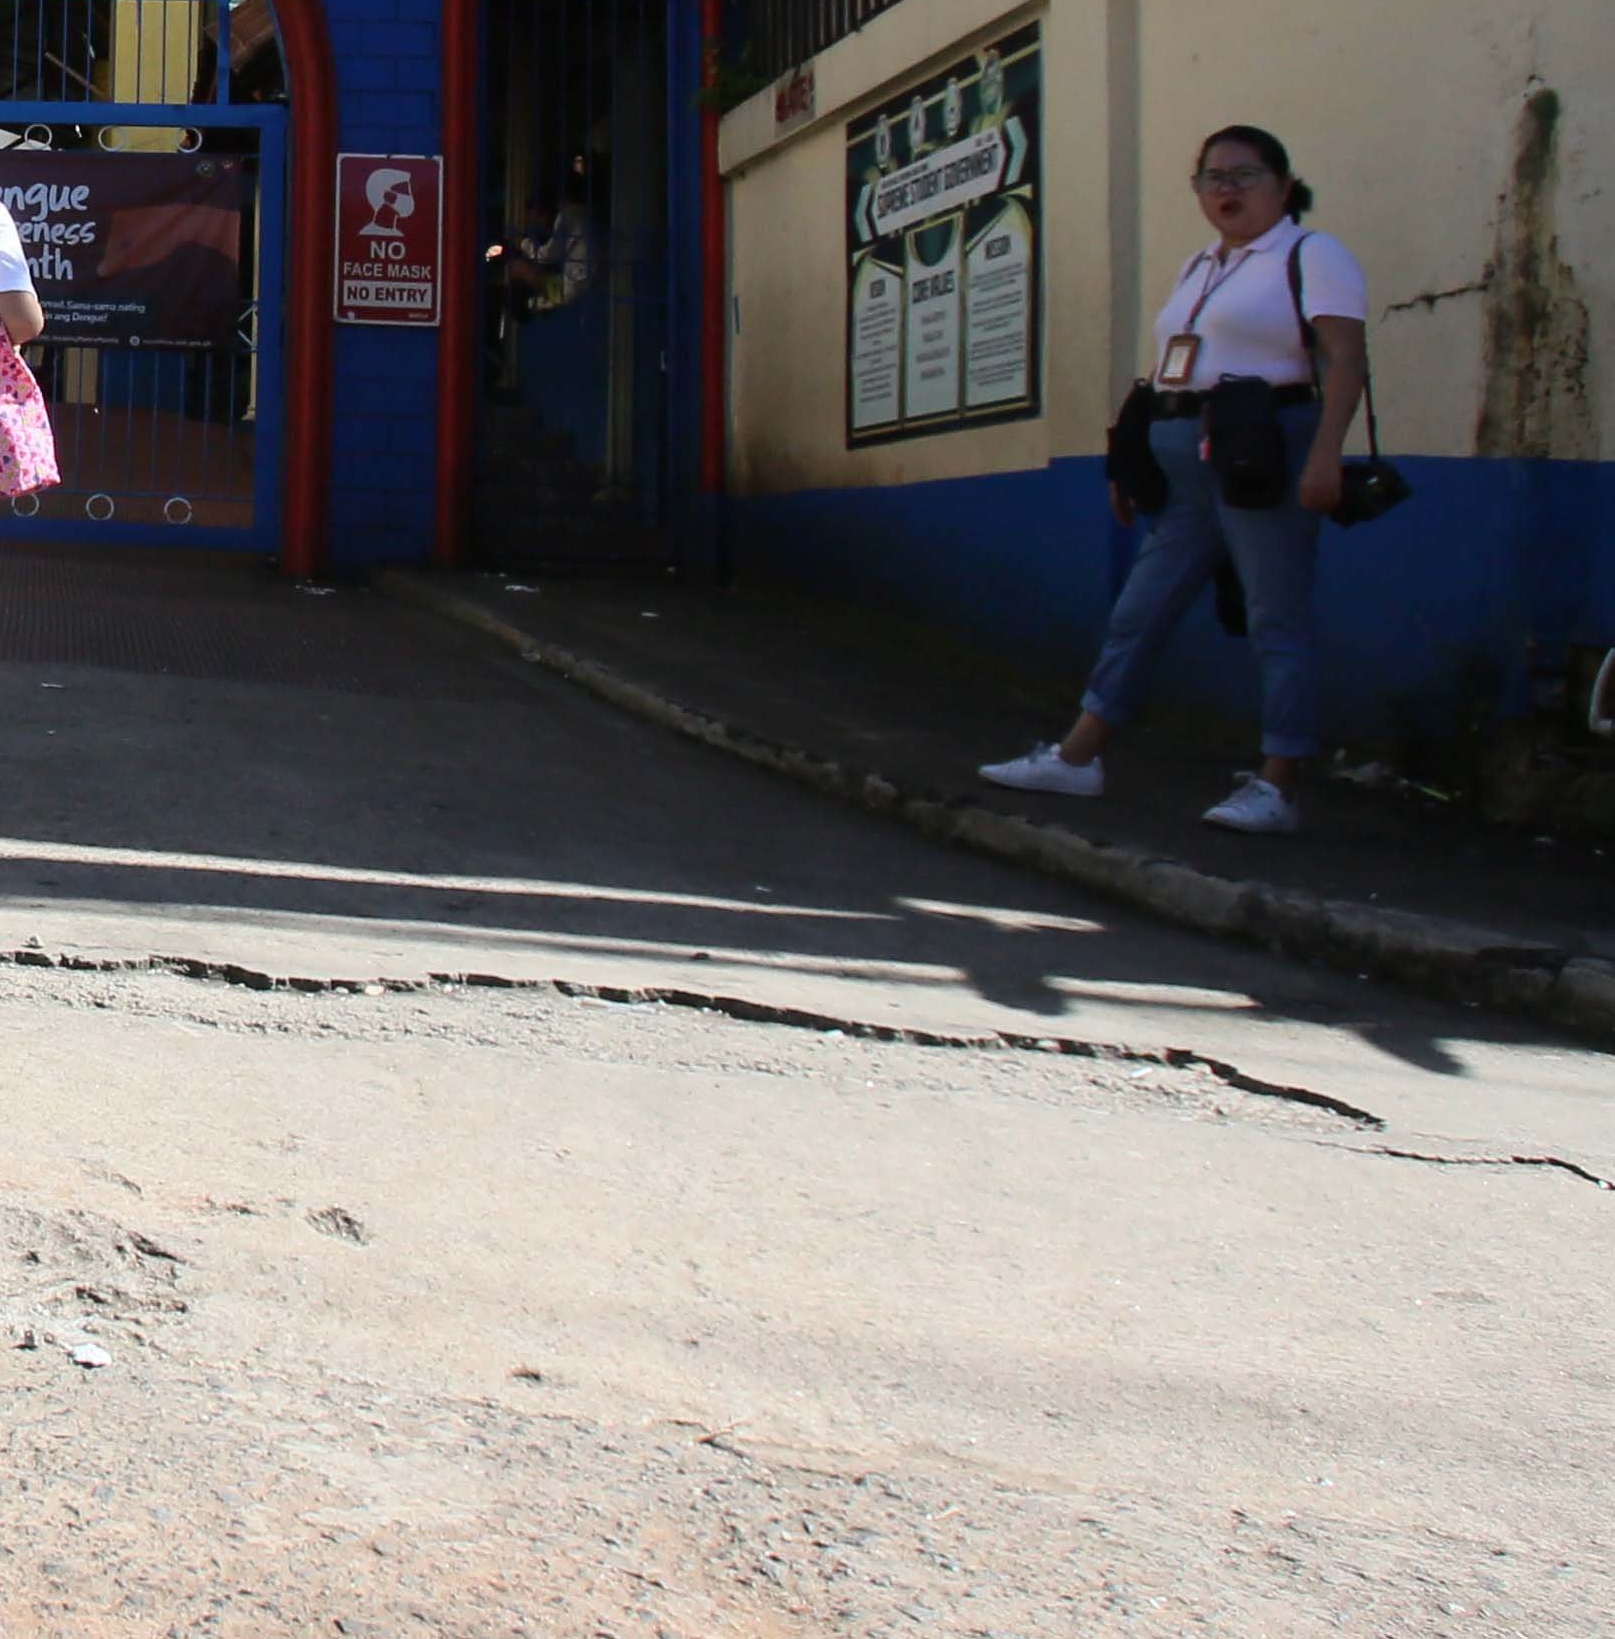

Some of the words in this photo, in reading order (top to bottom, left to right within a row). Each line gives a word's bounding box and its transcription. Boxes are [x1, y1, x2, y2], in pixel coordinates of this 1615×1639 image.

[370, 241, 405, 260] NO
[343, 262, 383, 277] FACE
[387, 264, 431, 280] MASK
[347, 286, 369, 301] NO
[375, 287, 428, 303] ENTRY
